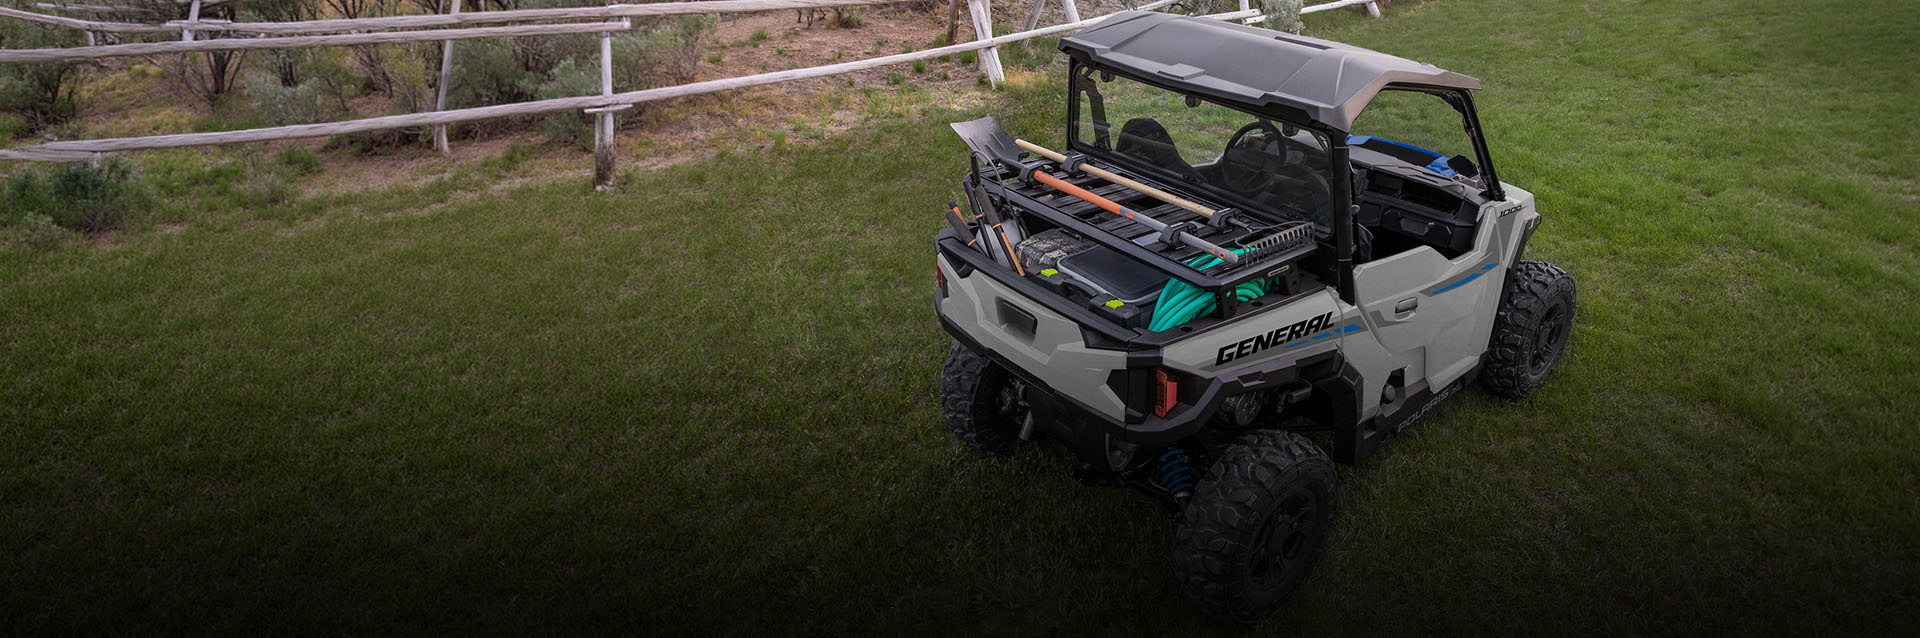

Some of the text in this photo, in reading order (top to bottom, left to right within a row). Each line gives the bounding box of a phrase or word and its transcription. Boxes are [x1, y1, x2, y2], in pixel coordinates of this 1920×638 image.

[1500, 205, 1522, 217] 1000
[1215, 311, 1335, 367] GENERAL
[1398, 389, 1449, 432] POLARIS
